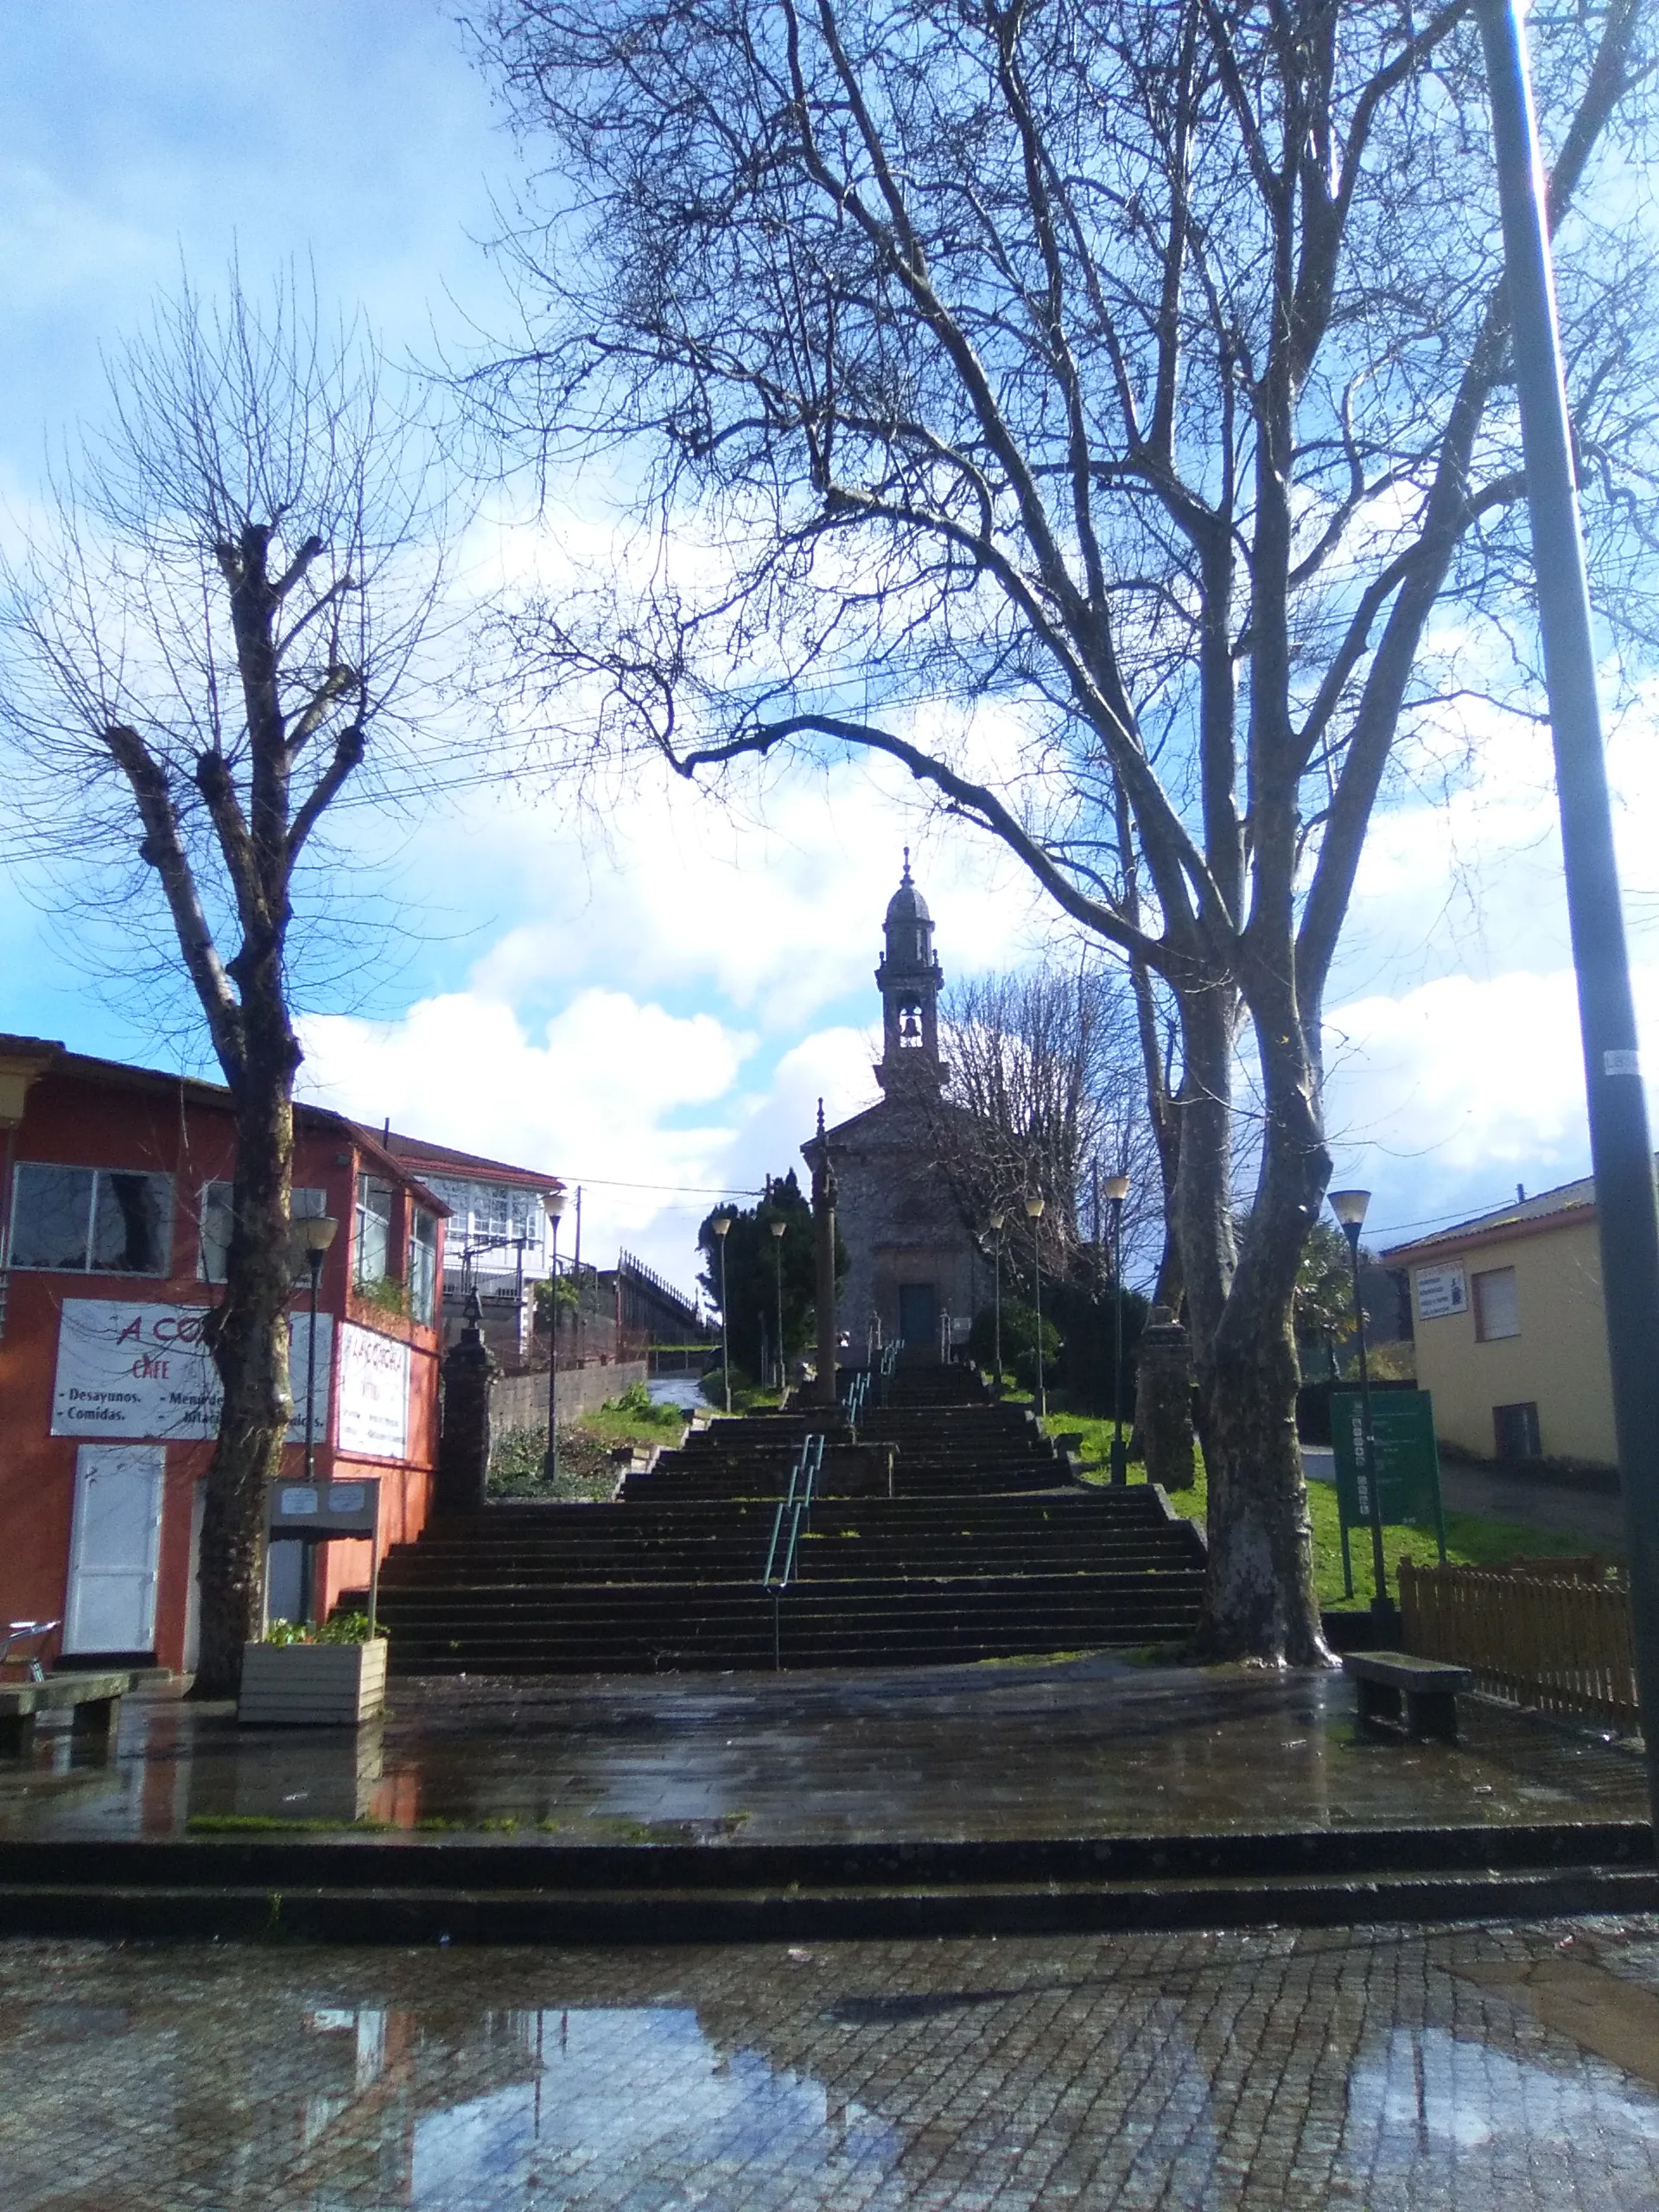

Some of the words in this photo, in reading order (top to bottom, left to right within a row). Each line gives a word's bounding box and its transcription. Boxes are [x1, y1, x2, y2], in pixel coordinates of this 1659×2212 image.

[116, 1315, 143, 1345] A
[69, 1388, 142, 1404] Desayunos.
[67, 1406, 125, 1421] Comidas.
